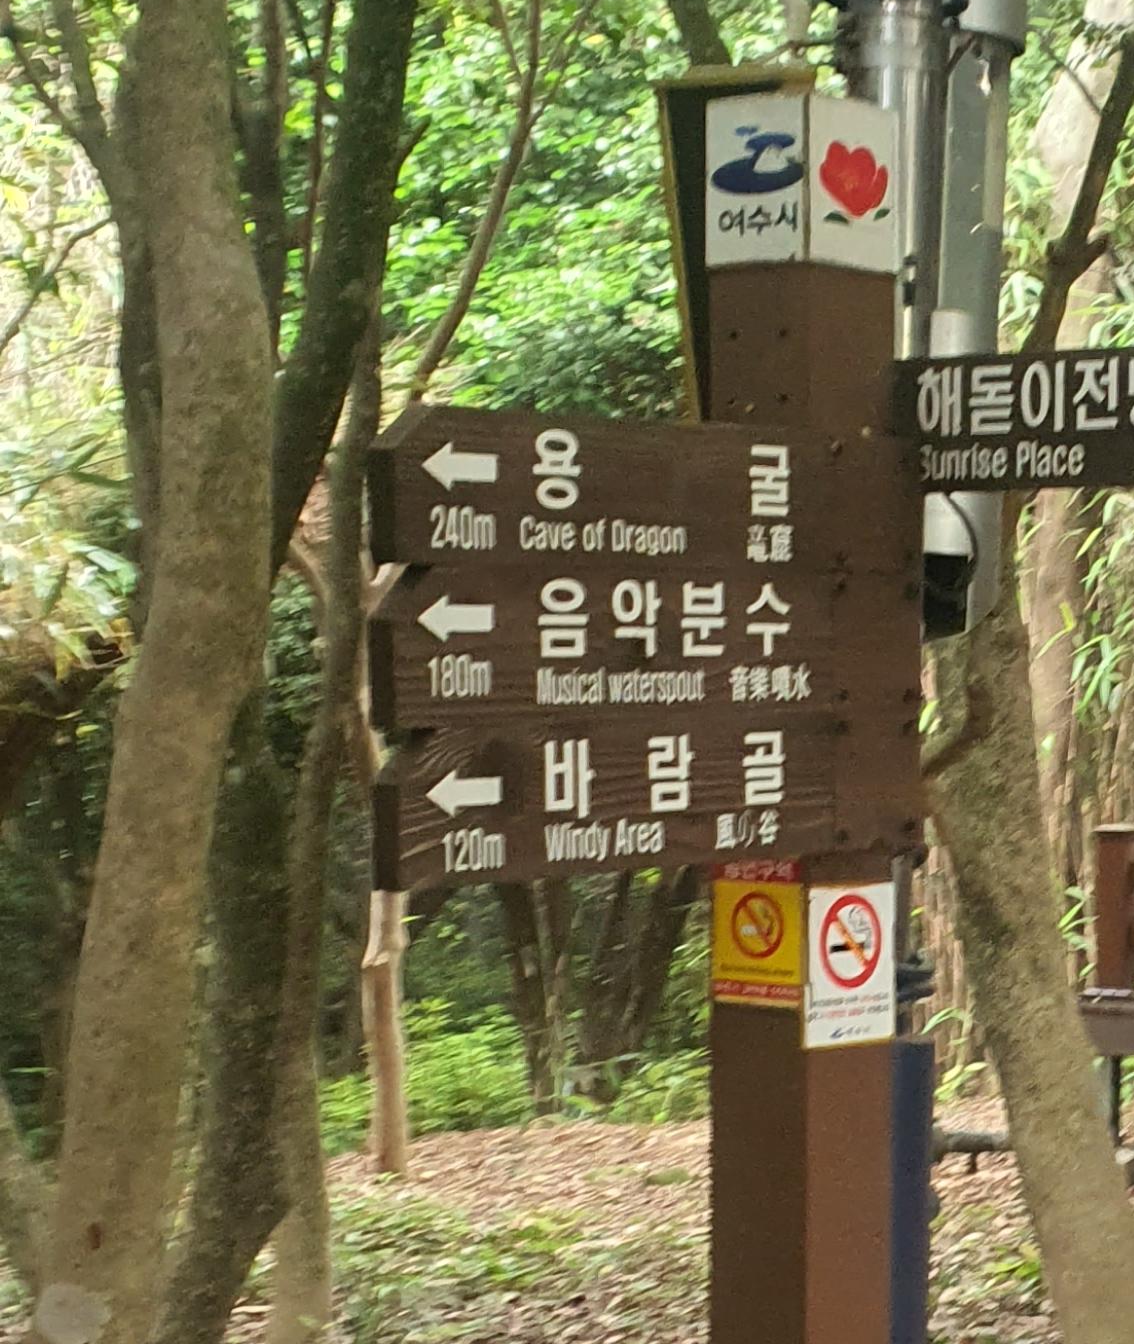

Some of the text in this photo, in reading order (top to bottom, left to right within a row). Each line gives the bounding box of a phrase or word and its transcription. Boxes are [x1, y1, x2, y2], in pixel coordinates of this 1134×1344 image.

[718, 202, 799, 235] 여수시
[919, 439, 1086, 481] Sunrise Place
[429, 504, 497, 551] 240m
[519, 516, 688, 557] Cave of Dragon
[427, 653, 493, 699] 180m
[536, 666, 707, 706] Musical waterspout
[440, 827, 508, 874] 120m
[543, 817, 666, 863] Windy Area
